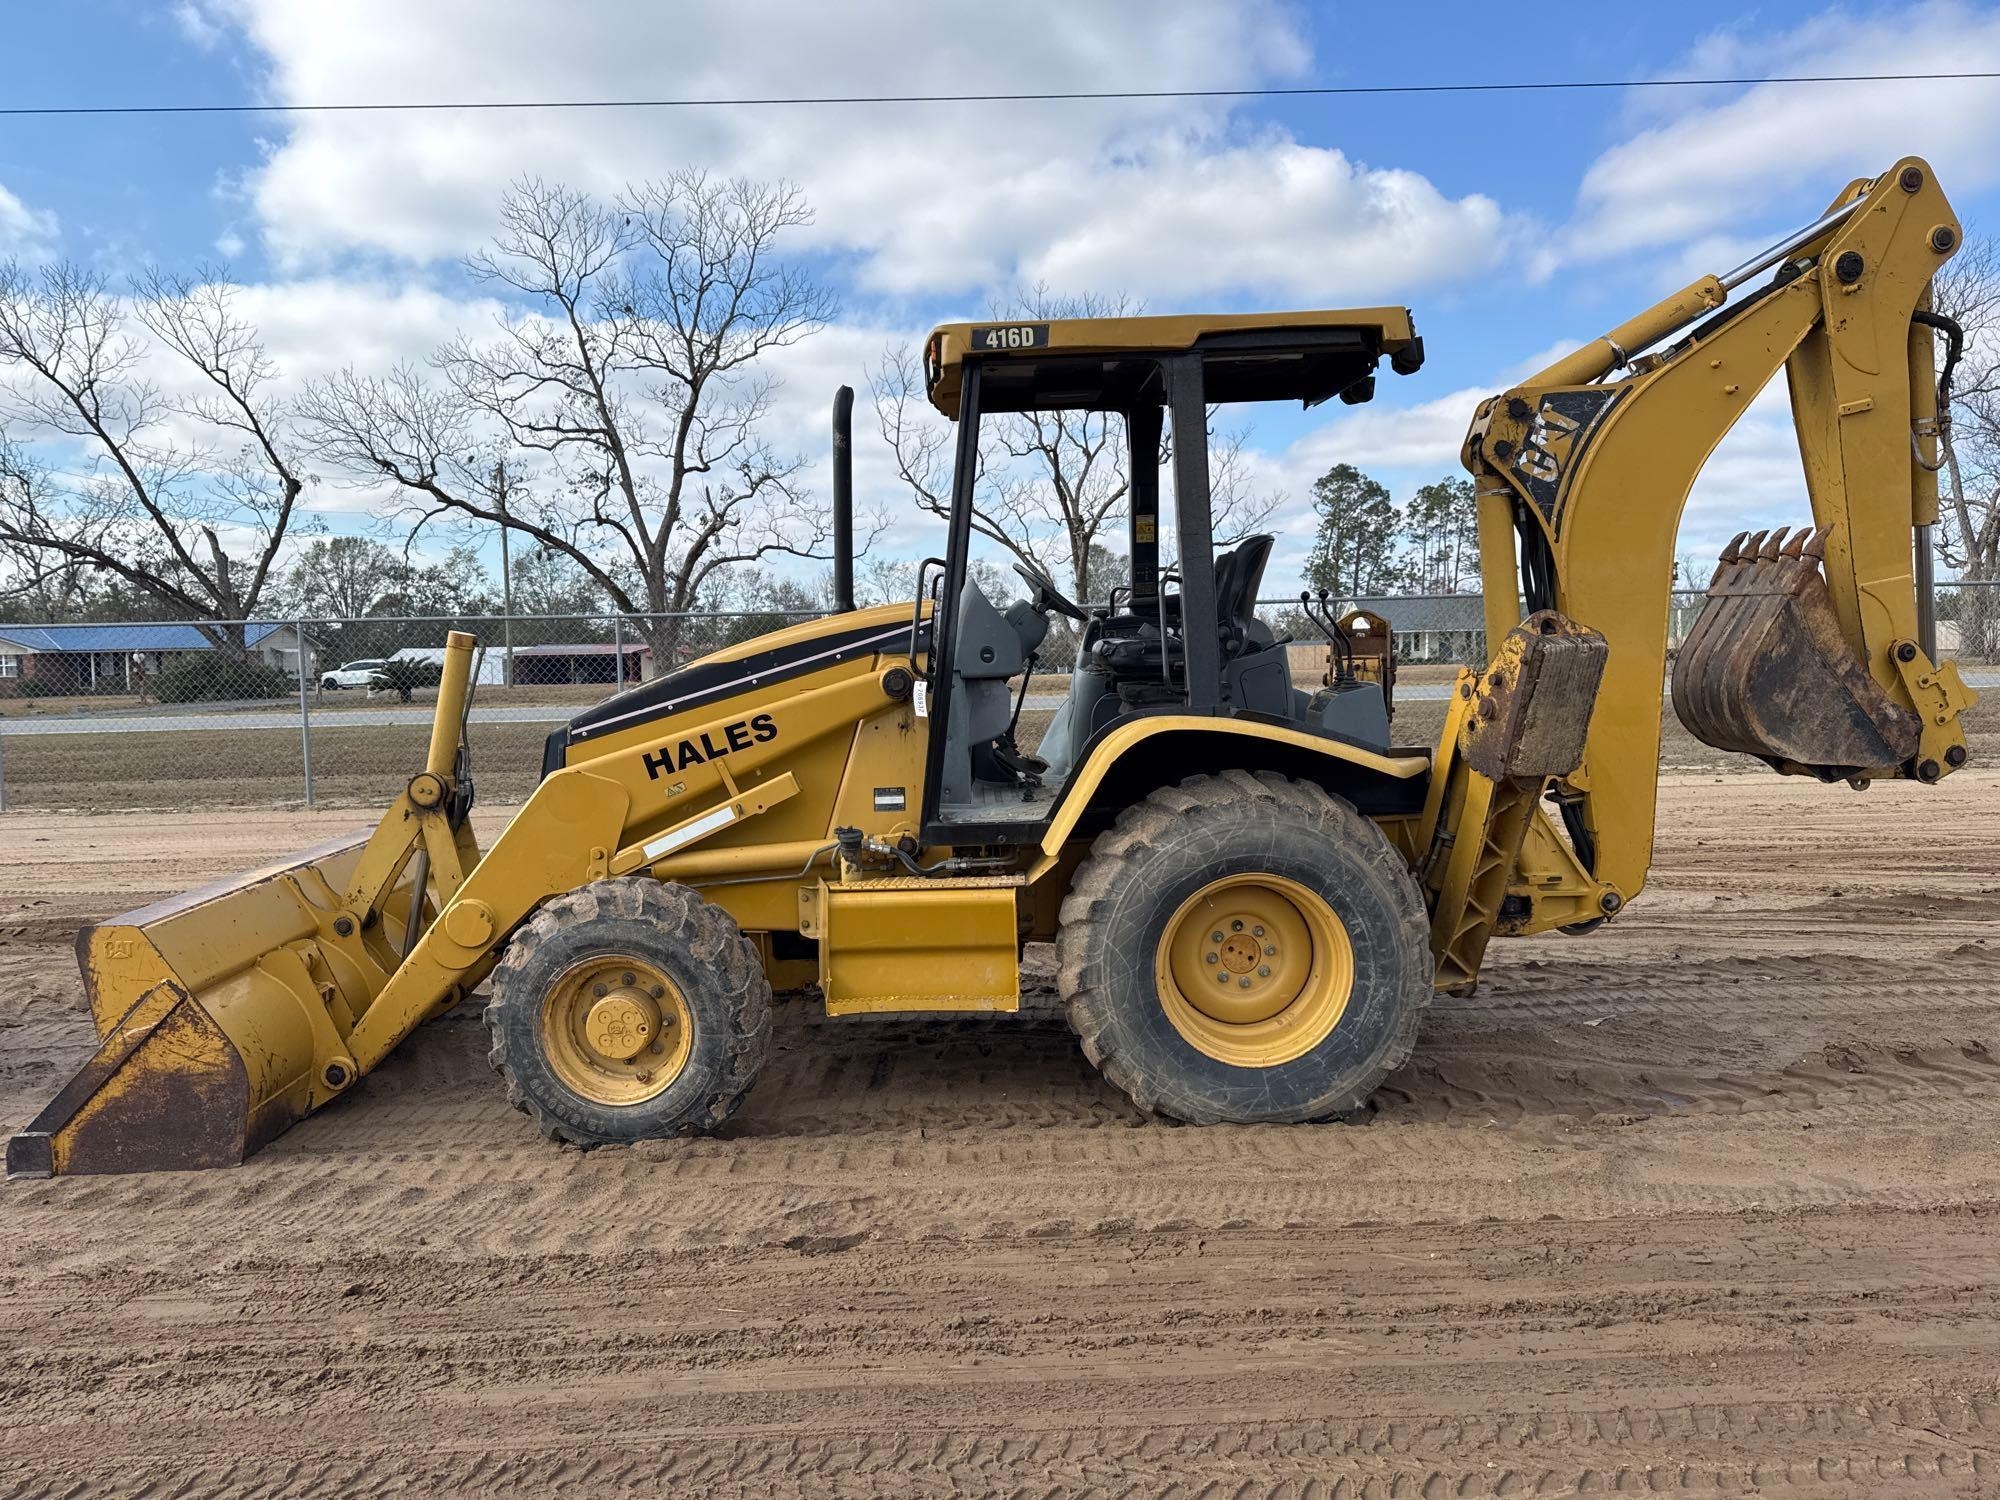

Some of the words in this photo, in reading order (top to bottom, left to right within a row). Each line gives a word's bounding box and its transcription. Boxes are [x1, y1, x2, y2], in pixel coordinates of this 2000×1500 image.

[986, 327, 1034, 348] 416D
[641, 713, 778, 781] HALES
[104, 940, 134, 960] CAT
